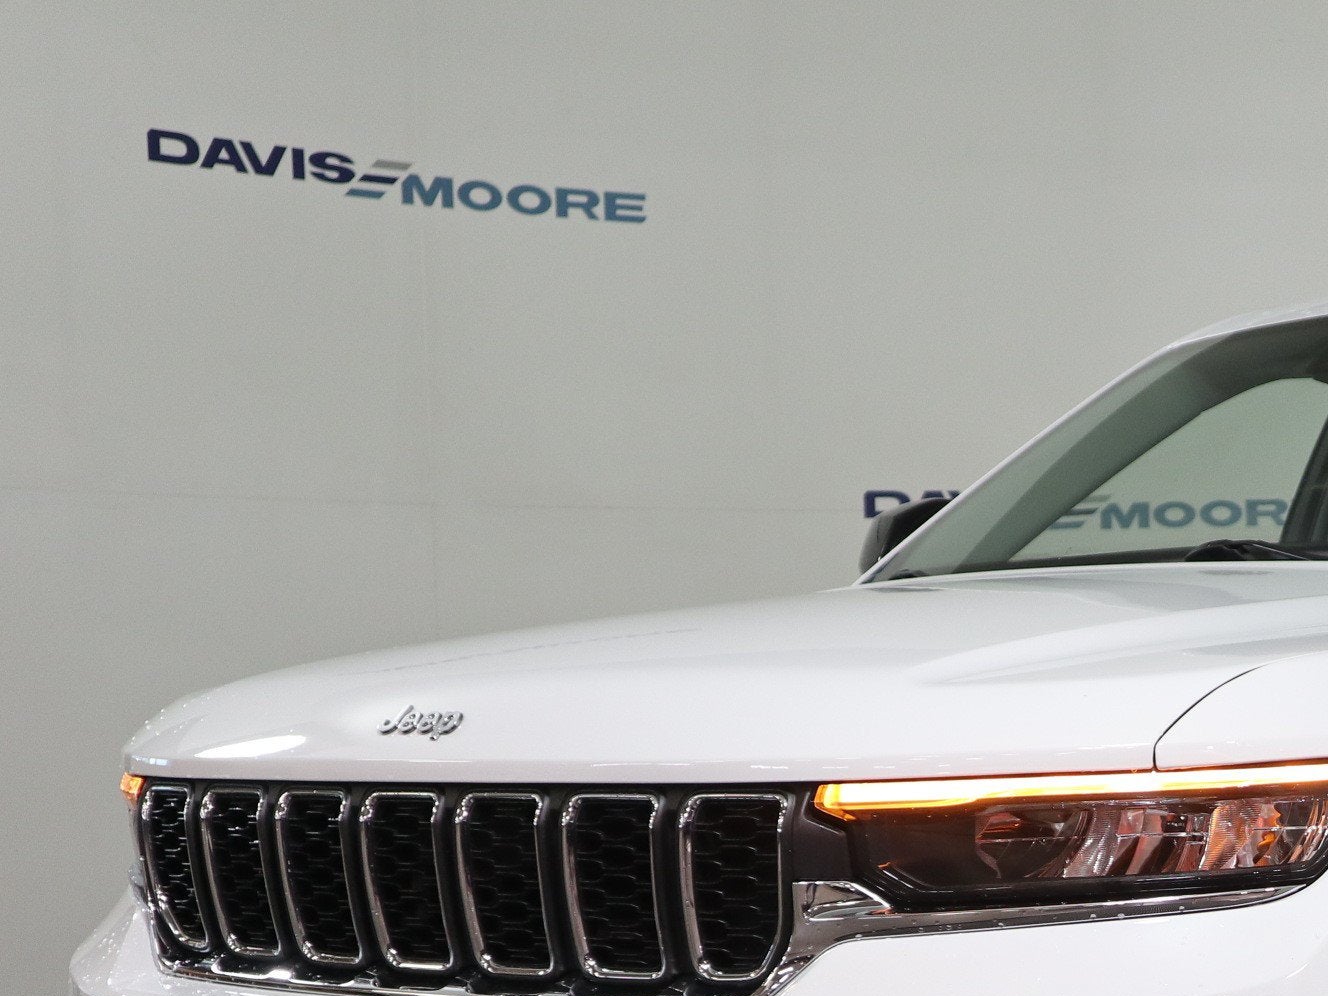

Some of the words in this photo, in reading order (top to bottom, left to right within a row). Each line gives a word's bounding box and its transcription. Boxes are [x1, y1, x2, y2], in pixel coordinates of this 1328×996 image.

[147, 129, 356, 184] DAVIS
[401, 174, 647, 224] MOORE
[377, 704, 464, 741] Jeep
